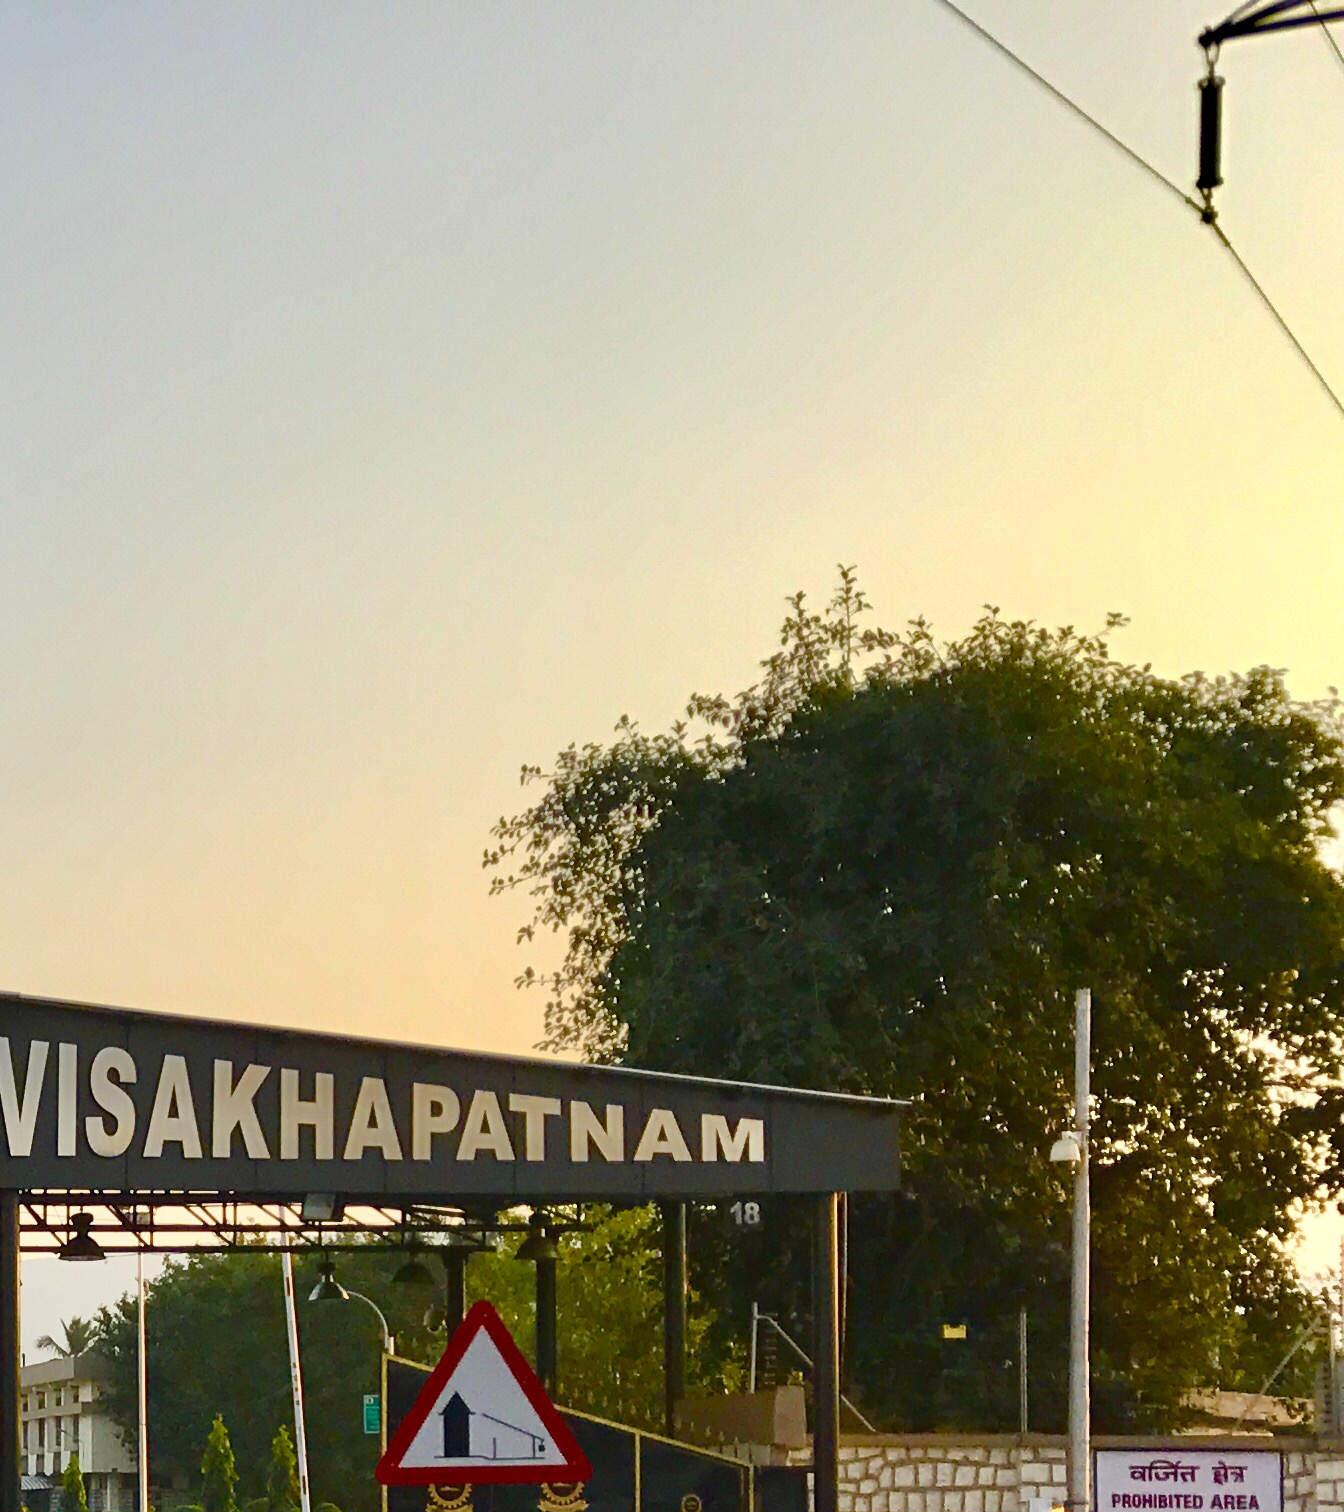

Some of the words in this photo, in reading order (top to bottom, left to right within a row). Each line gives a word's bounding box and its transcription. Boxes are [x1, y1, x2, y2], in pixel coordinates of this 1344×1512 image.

[730, 1201, 761, 1225] 18
[1129, 1459, 1201, 1483] वर्जित
[1211, 1460, 1248, 1485] क्षेत्र
[1111, 1493, 1204, 1510] PROHIBITED
[1209, 1494, 1260, 1510] AREA
